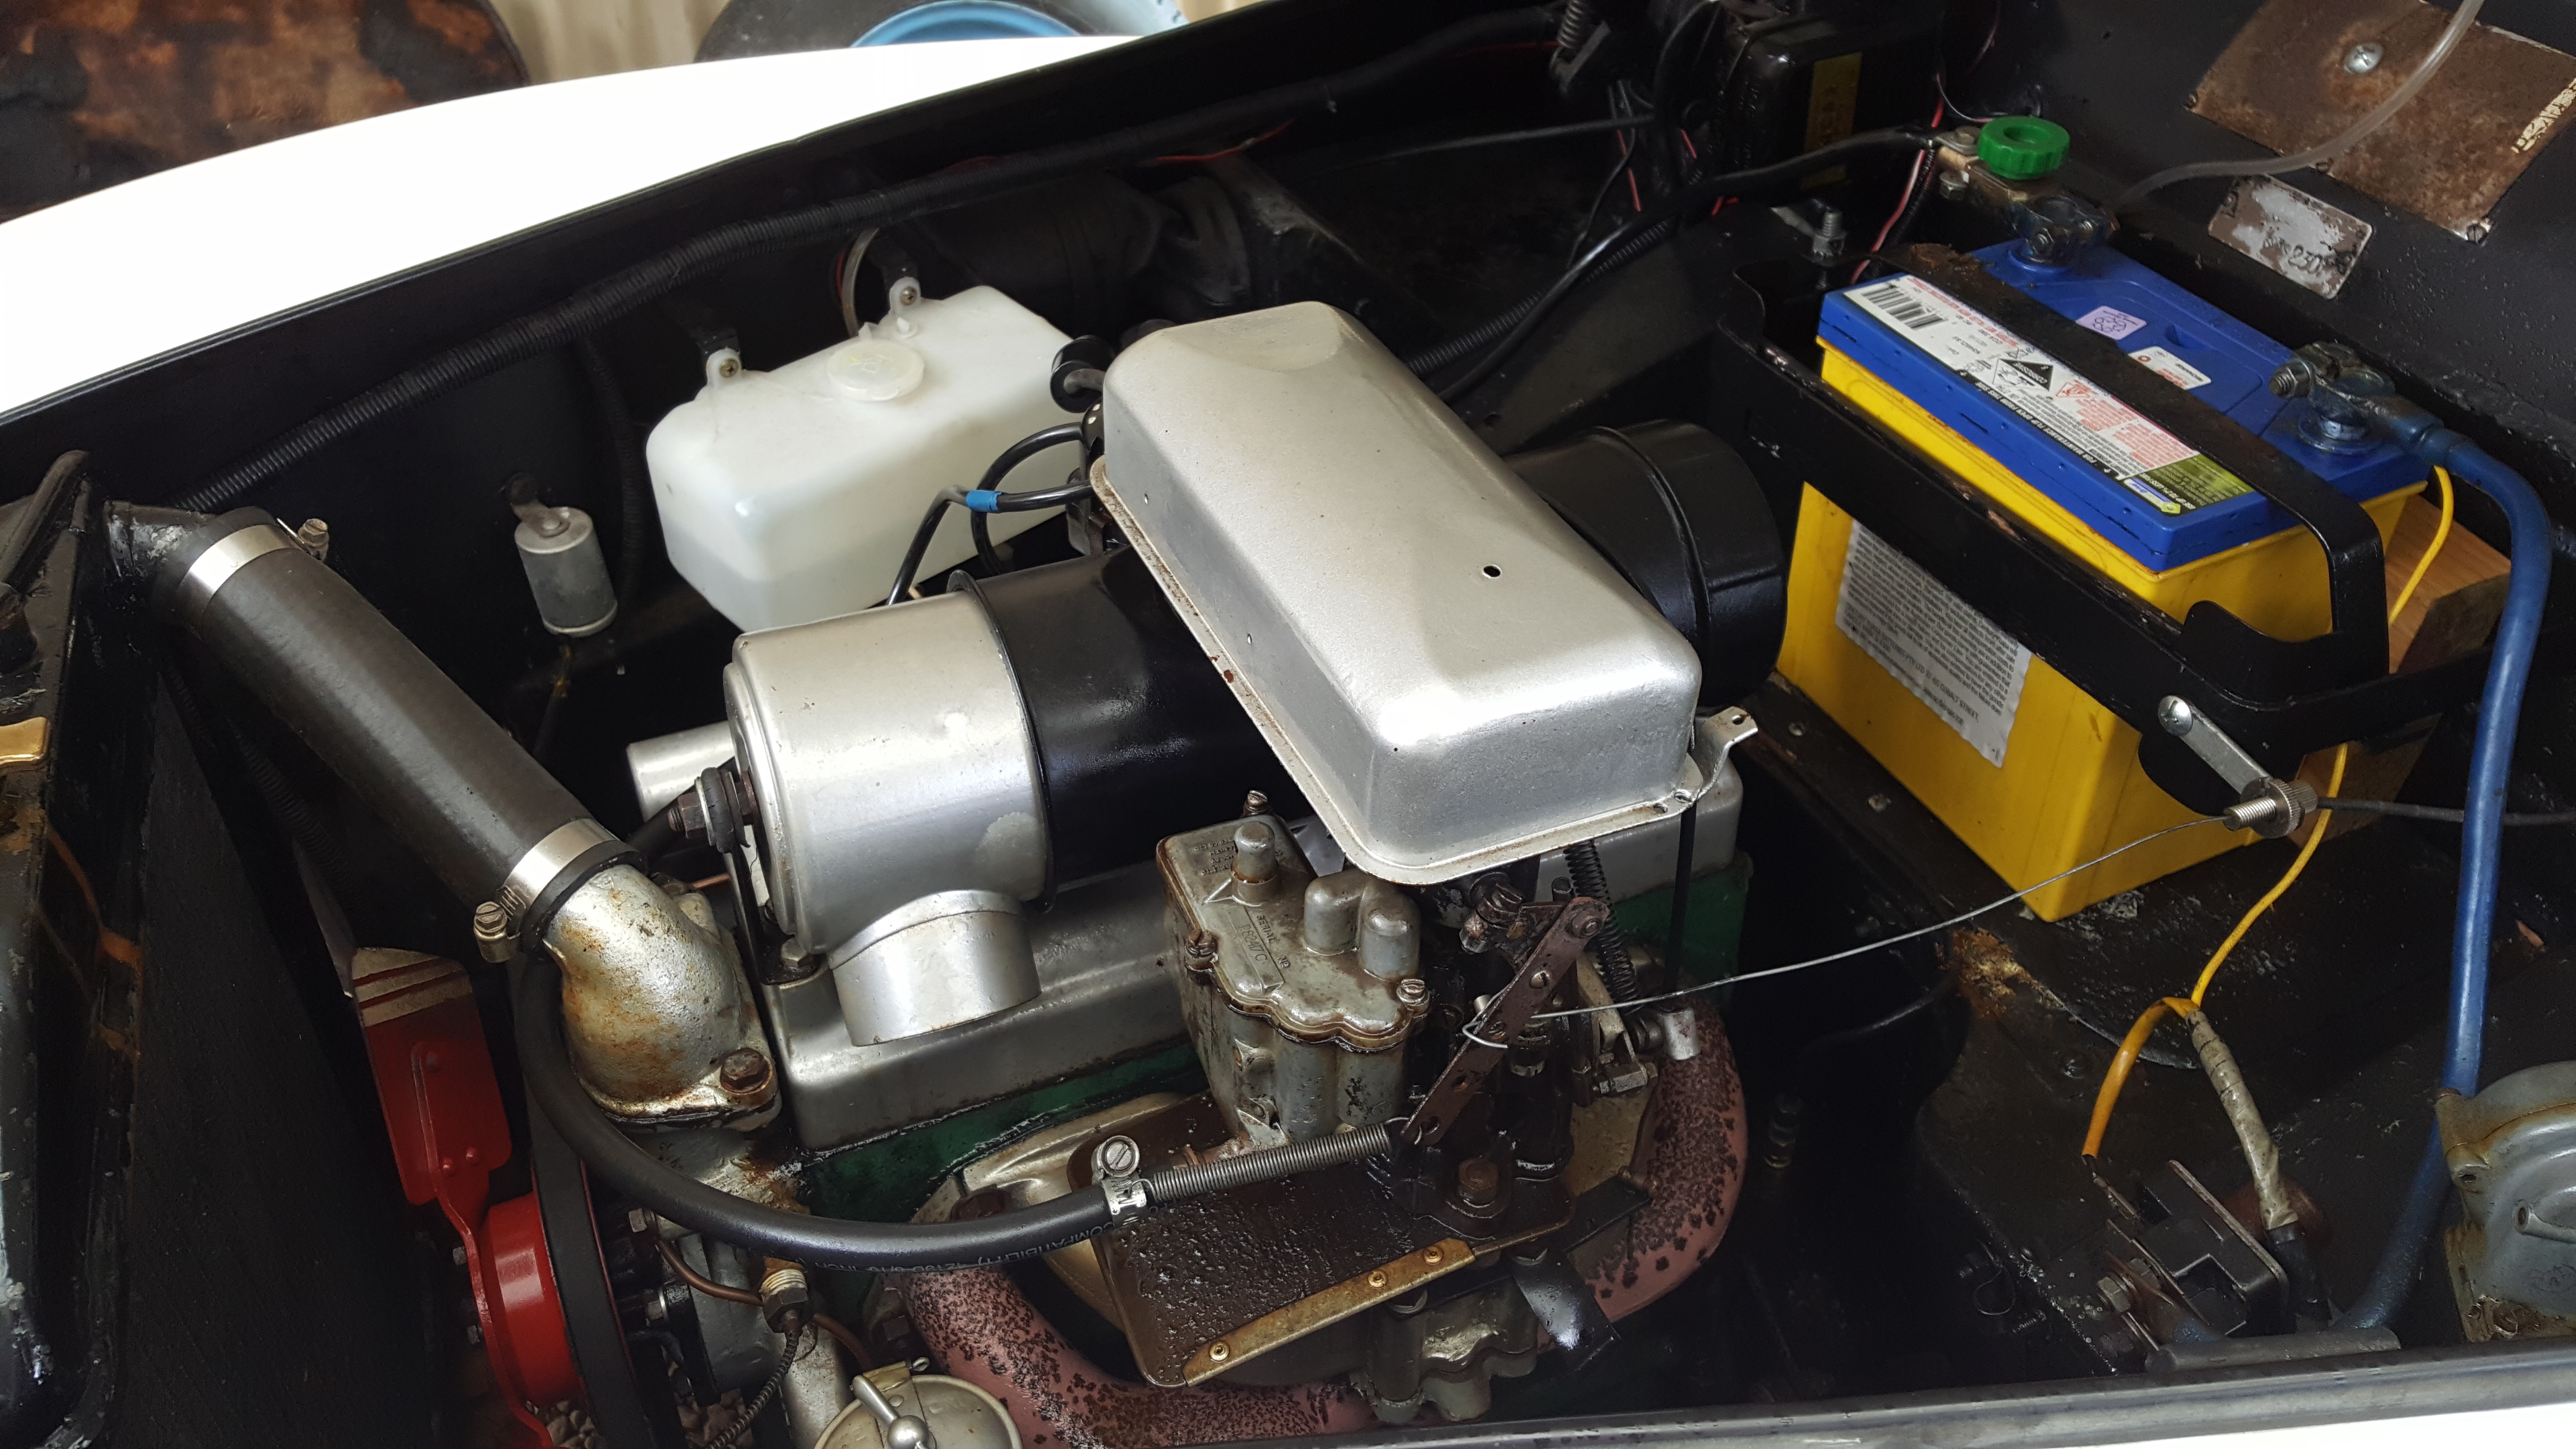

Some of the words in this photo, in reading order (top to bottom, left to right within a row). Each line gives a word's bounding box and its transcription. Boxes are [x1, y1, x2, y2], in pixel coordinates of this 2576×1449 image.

[2010, 361, 2049, 384] CORROSIVE
[1986, 389, 2003, 399] THIS
[1998, 398, 2020, 410] FROM
[2014, 408, 2034, 419] OPEN
[2029, 418, 2047, 428] FLIP
[2042, 427, 2086, 454] MAINTENANCE
[2080, 453, 2098, 463] FOR
[1254, 914, 1278, 944] SERIAL
